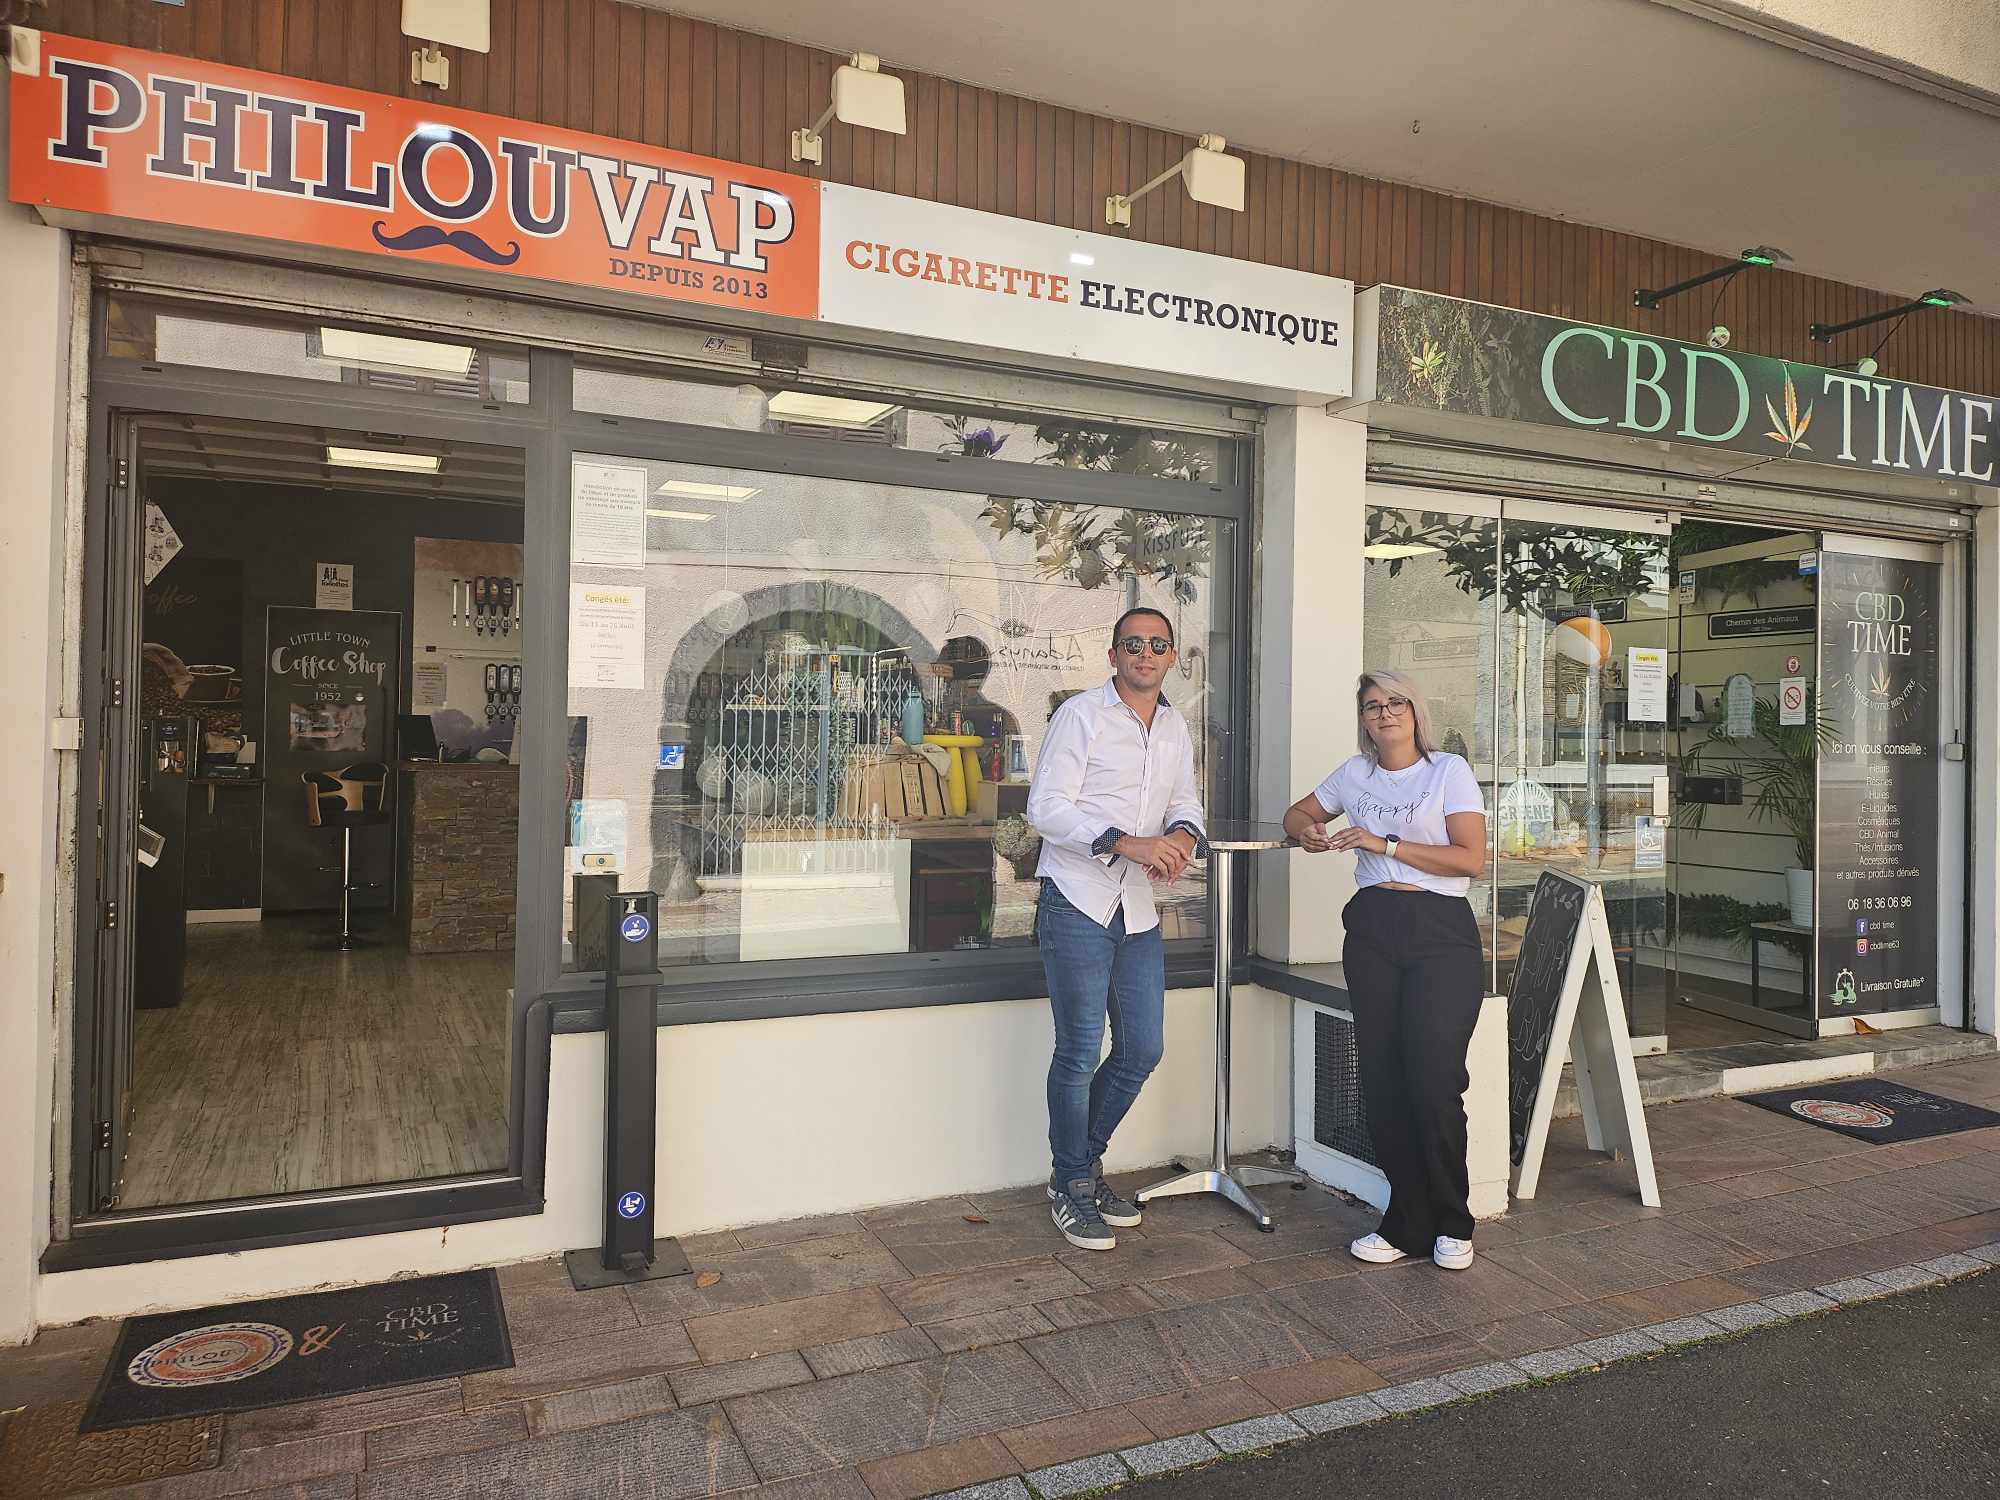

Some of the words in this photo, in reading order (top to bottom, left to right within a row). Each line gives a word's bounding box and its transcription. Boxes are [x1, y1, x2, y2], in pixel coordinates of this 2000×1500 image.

[48, 56, 795, 274] PHILOUVAP
[609, 257, 704, 292] DEPUIS
[712, 273, 769, 300] 2013
[845, 240, 1069, 304] CIGARETTE
[1080, 280, 1339, 347] ELECTRONIQUE
[1541, 326, 1750, 443] CBD
[1823, 374, 1993, 482] TIME
[1855, 591, 1905, 622] CBD
[1726, 618, 1752, 627] Chemin
[1753, 615, 1766, 625] des
[289, 631, 331, 646] LITTLE
[335, 632, 370, 648] TOWN
[1847, 620, 1912, 656] TIME
[271, 646, 340, 680] Coffee
[343, 650, 387, 687] Shop
[314, 691, 343, 702] 1952
[1831, 740, 1843, 754] Ici
[1845, 743, 1857, 754] on
[1860, 743, 1882, 755] vous
[1354, 791, 1426, 824] happy
[1861, 802, 1897, 814] E-Liquides
[1859, 828, 1875, 839] CBD
[1876, 828, 1900, 839] Animal
[1836, 870, 1844, 880] et
[1845, 869, 1866, 879] autres
[1868, 867, 1895, 881] produits
[1847, 898, 1859, 911] 06
[1862, 897, 1873, 910] 18
[1874, 896, 1886, 909] 36
[1887, 896, 1899, 908] 06
[1900, 895, 1912, 908] 96
[1869, 920, 1881, 930] cbd
[1860, 981, 1893, 992] Livraison
[376, 1310, 459, 1332] TIME
[386, 1303, 449, 1322] CBD
[299, 1321, 347, 1356] &
